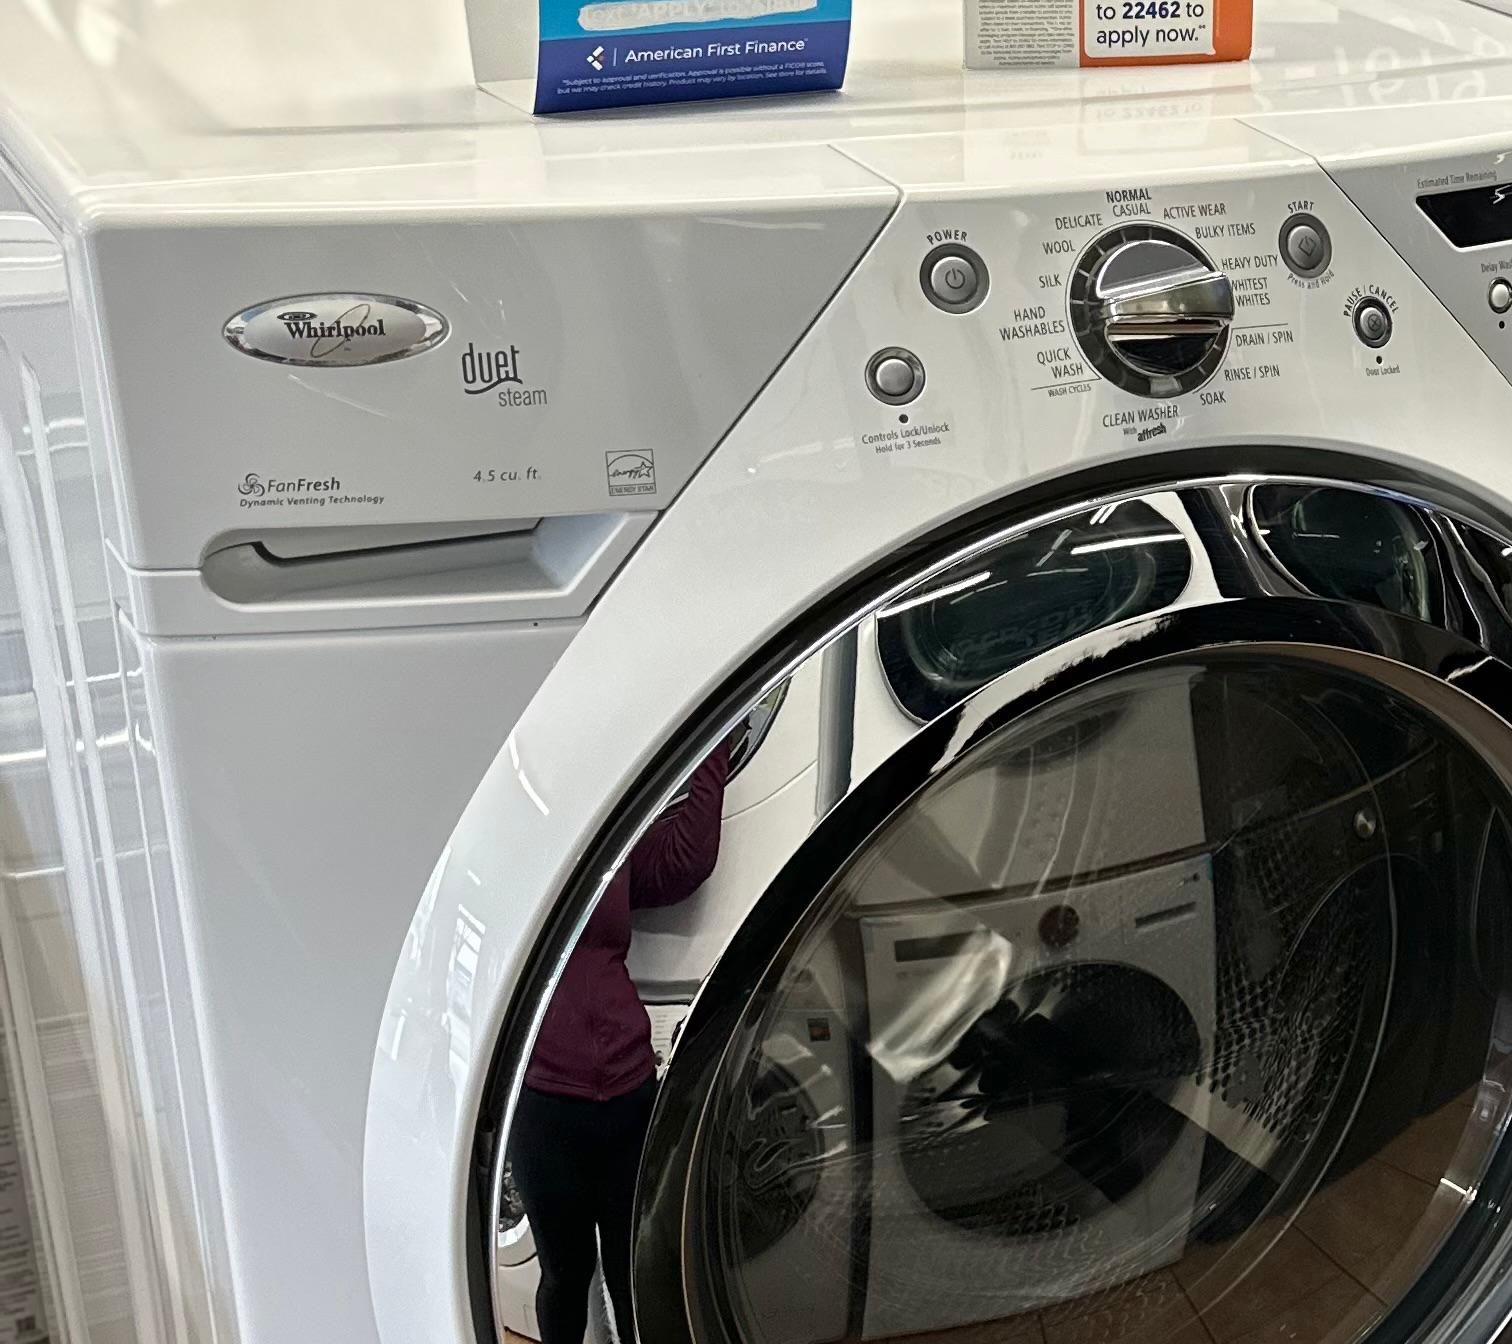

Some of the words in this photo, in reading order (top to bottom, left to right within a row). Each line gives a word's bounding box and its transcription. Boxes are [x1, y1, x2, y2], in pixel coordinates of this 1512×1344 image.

[1096, 3, 1116, 20] to
[1122, 1, 1181, 20] 22462
[1186, 2, 1205, 18] to
[1096, 25, 1150, 48] apply
[625, 46, 703, 63] American
[707, 42, 741, 57] First
[745, 39, 805, 54] Finance
[1106, 187, 1152, 204] NORMAL
[1112, 203, 1151, 218] CASUAL
[1163, 205, 1197, 221] ACTIVE
[1197, 202, 1227, 217] WEAR
[1287, 200, 1315, 214] START
[1055, 213, 1104, 231] DELICATE
[1195, 224, 1225, 240] BULKY
[1227, 222, 1256, 237] ITEMS
[926, 229, 968, 245] POWER
[1042, 239, 1076, 255] WOOL
[1221, 256, 1251, 271] HEAVY
[1253, 254, 1279, 268] DUTY
[1039, 274, 1063, 288] SILK
[1231, 277, 1268, 291] WHITEST
[1235, 293, 1271, 308] WHITES
[1343, 286, 1363, 318] PAUSE
[1369, 284, 1400, 314] CANCEL
[1014, 306, 1046, 322] HAND
[284, 318, 386, 342] Whirlpool
[999, 319, 1065, 341] WASHABLES
[1235, 332, 1266, 347] DRAIN
[1270, 329, 1294, 344] SPIN
[1036, 347, 1072, 366] QUICK
[460, 342, 524, 392] duet
[1050, 363, 1084, 380] WASH
[1224, 367, 1252, 382] RINSE
[1258, 364, 1281, 379] SPIN
[497, 387, 548, 408] steam
[1047, 386, 1067, 398] WASH
[1068, 383, 1092, 394] CYCLES
[1199, 390, 1226, 406] SOAK
[1102, 409, 1135, 428] CLEAN
[1137, 404, 1179, 424] WASHER
[861, 431, 899, 445] Controls
[900, 422, 950, 439] Lock/Unlock
[1137, 422, 1167, 442] affresh
[875, 444, 893, 454] Hold
[894, 442, 905, 451] for
[906, 440, 912, 449] 3
[912, 437, 942, 449] Seconds
[473, 469, 495, 483] 4.5
[499, 470, 523, 482] cu.
[525, 467, 542, 481] ft.
[267, 476, 341, 494] FanFresh
[239, 496, 284, 509] Dynamic
[286, 495, 326, 508] Venting
[328, 494, 385, 507] Technology
